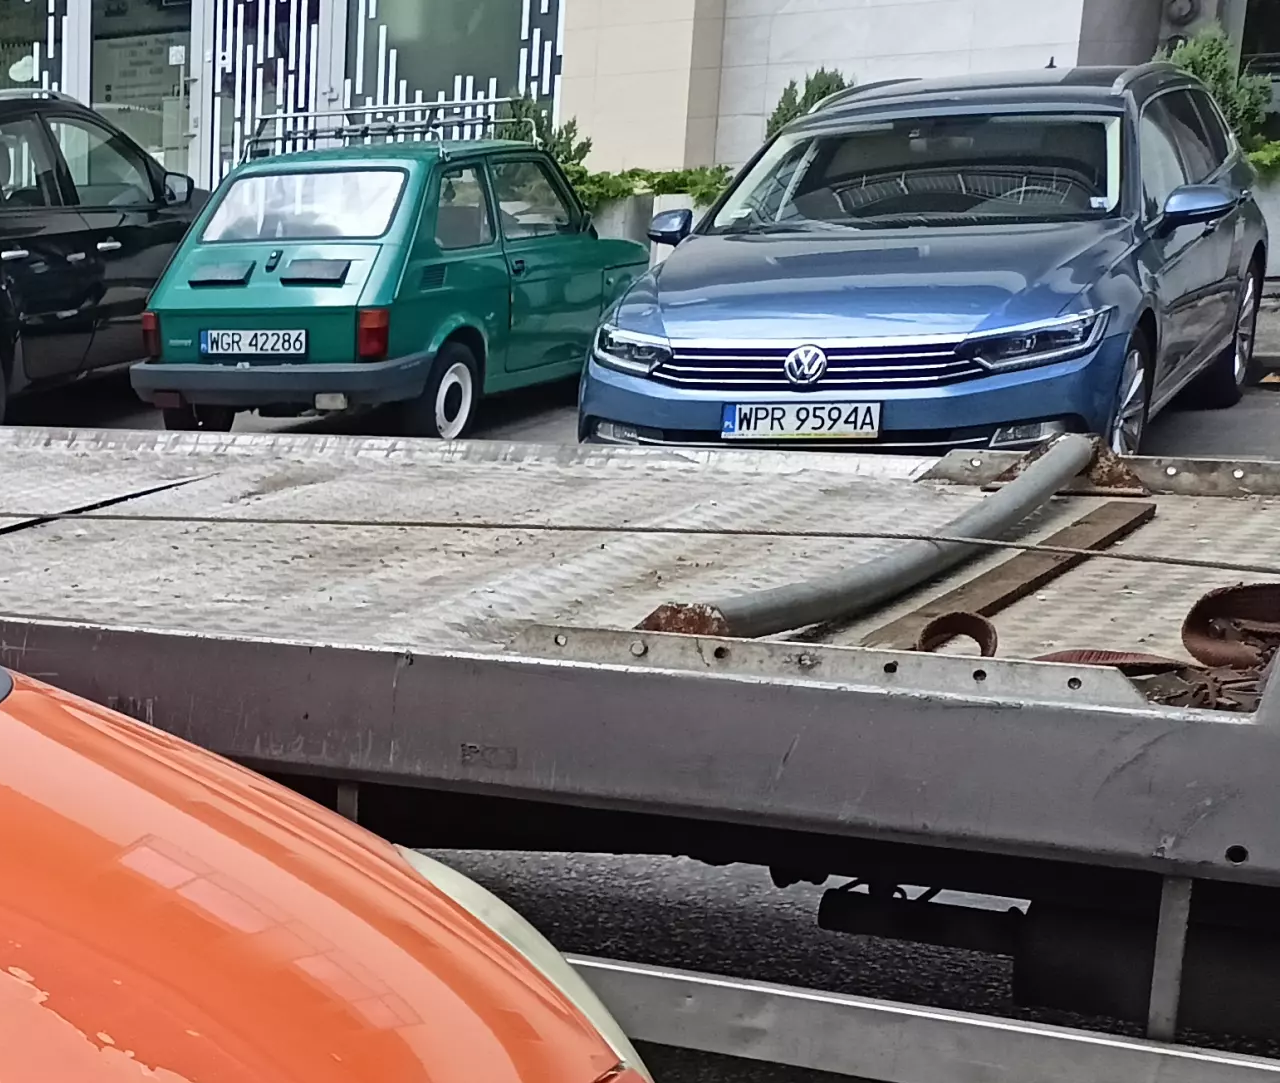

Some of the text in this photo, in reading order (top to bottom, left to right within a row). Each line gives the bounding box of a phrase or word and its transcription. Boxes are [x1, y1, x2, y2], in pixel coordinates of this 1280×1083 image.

[209, 332, 242, 352] WGR
[248, 332, 303, 352] 42286
[738, 406, 875, 431] WPR 9594A
